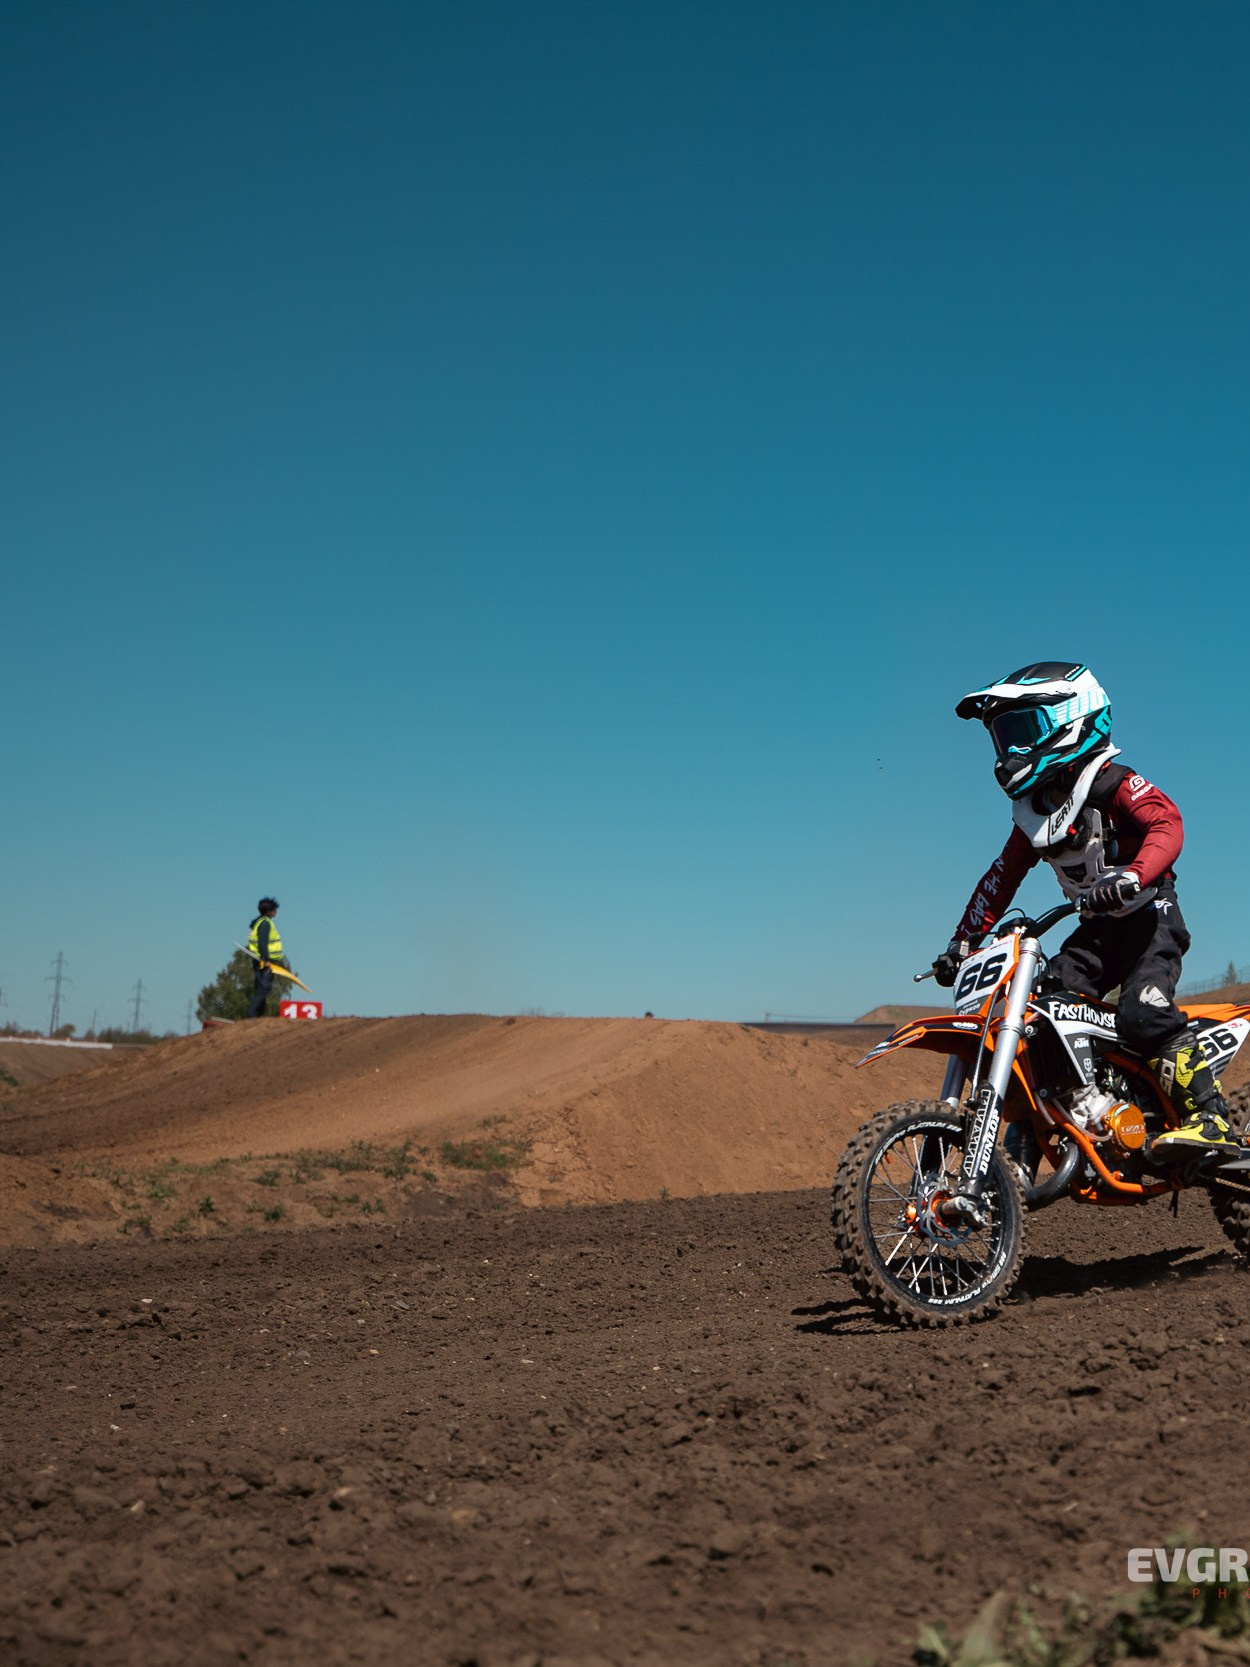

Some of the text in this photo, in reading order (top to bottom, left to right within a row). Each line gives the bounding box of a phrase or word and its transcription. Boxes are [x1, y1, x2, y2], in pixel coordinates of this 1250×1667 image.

[1052, 791, 1075, 836] LEATT
[955, 953, 1007, 1003] 66
[1074, 1037, 1090, 1049] KTM
[1198, 1028, 1239, 1062] 66
[979, 1108, 1000, 1176] DUNLOP
